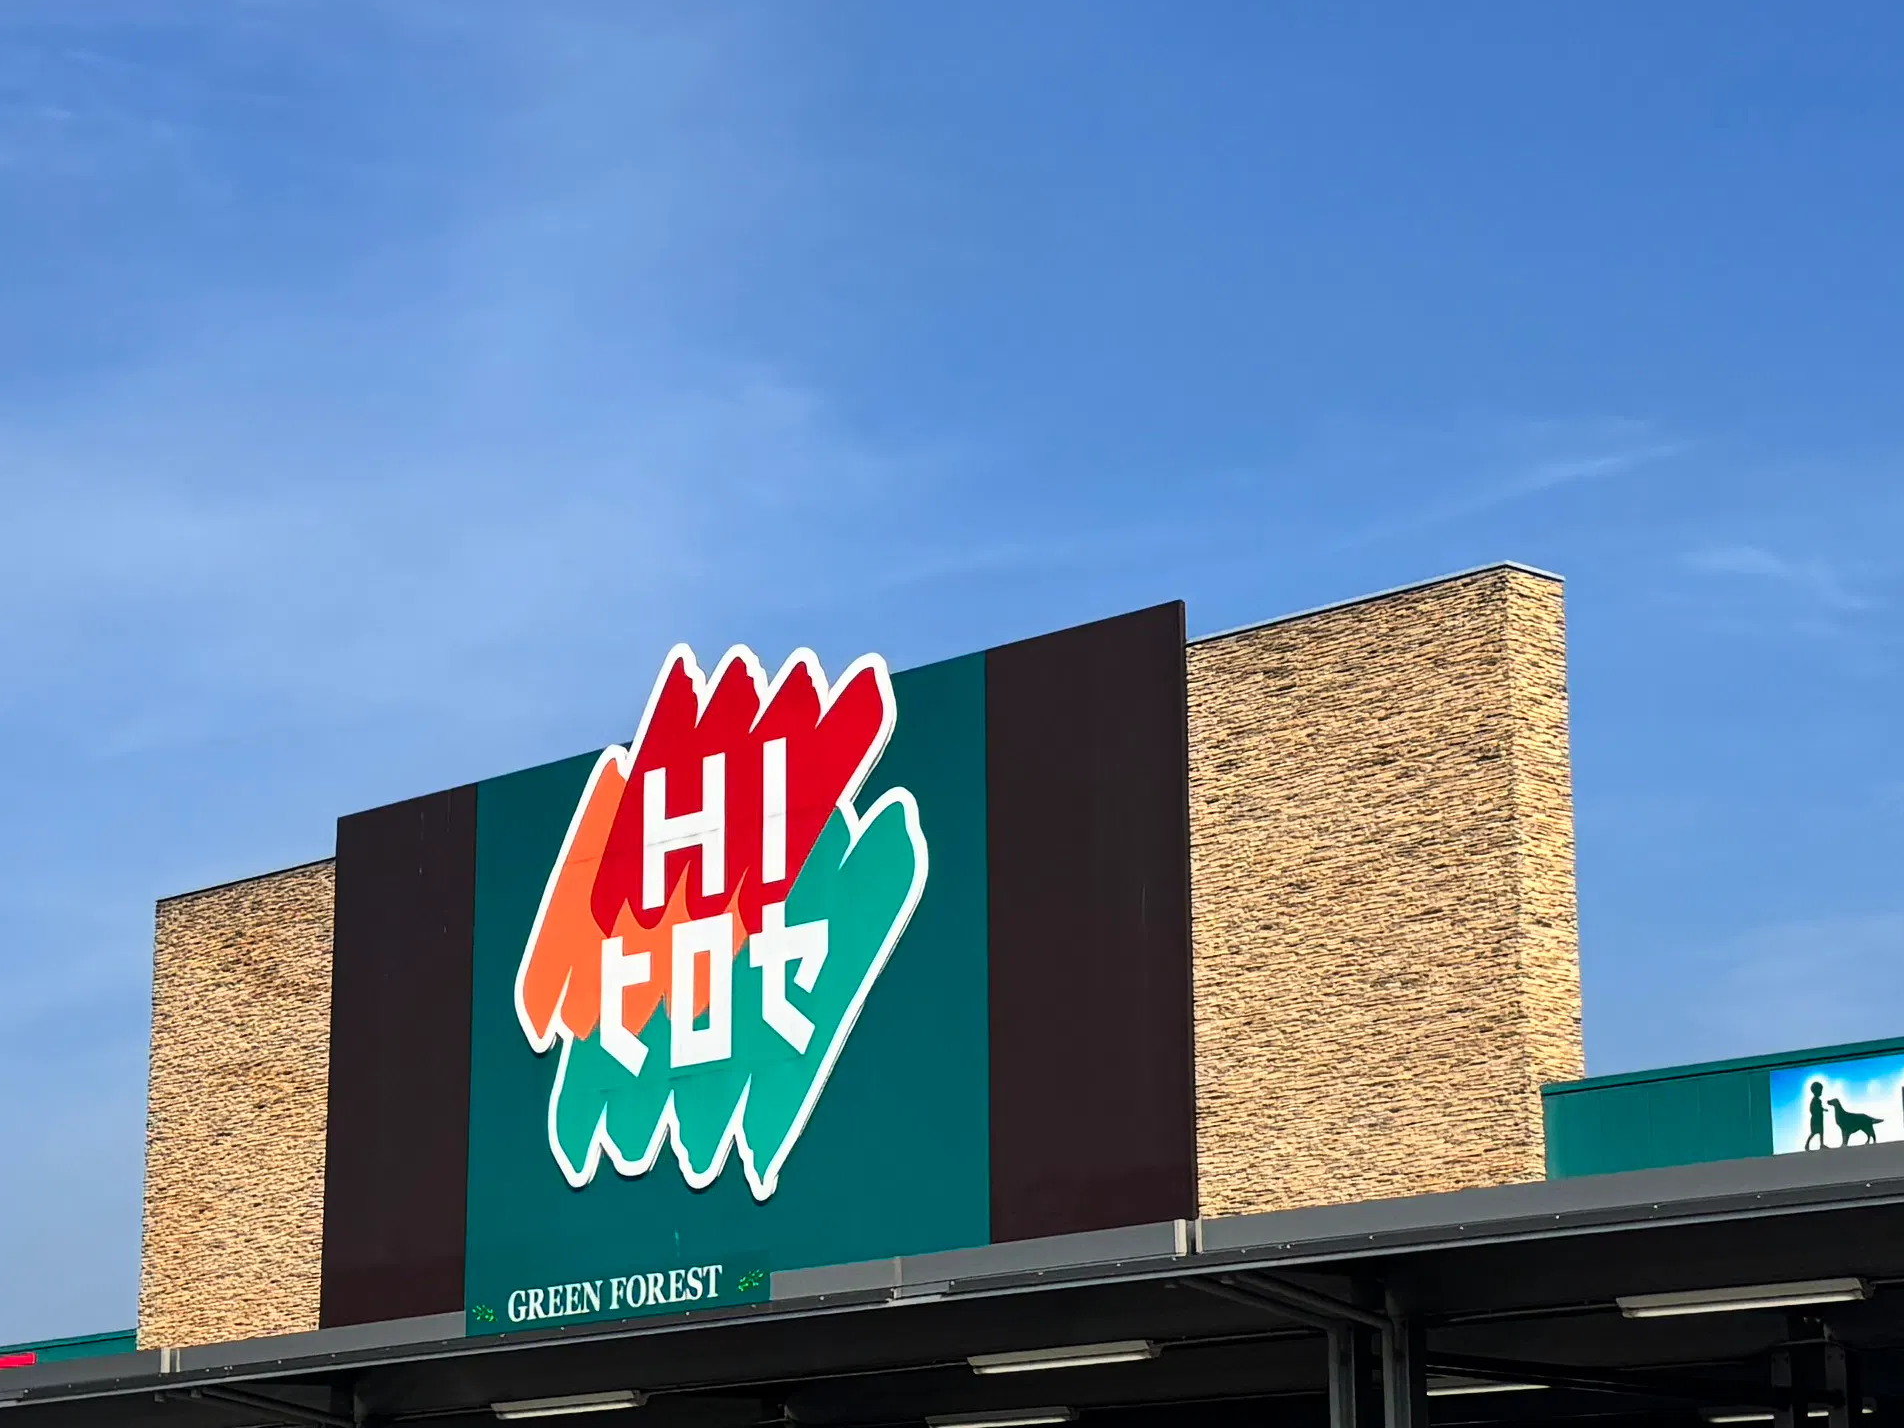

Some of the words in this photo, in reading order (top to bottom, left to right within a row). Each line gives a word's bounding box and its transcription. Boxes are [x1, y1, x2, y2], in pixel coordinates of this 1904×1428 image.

[643, 737, 786, 910] HI
[601, 901, 828, 1076] ヒロセ
[507, 1277, 602, 1324] GREEN
[609, 1264, 723, 1310] FOREST
